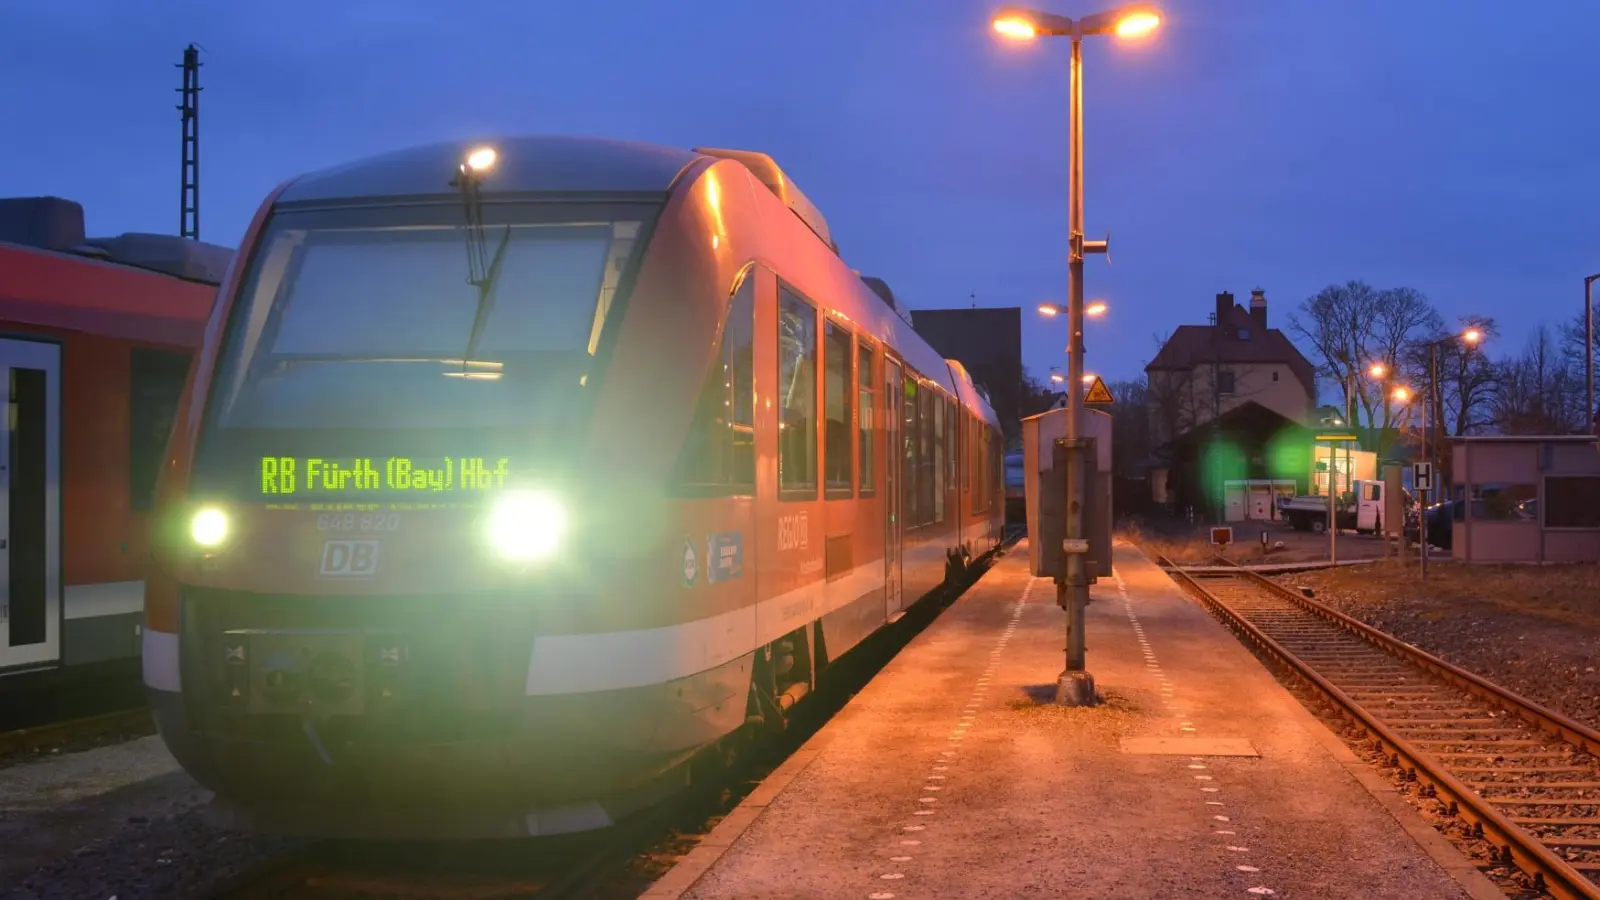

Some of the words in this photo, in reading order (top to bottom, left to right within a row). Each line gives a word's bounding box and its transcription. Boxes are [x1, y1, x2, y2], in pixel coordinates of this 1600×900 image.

[261, 457, 296, 494] RB
[307, 458, 380, 490] Fürth
[386, 456, 453, 492] (Bay)
[460, 457, 509, 491] Hbf
[1414, 463, 1430, 488] H
[321, 540, 378, 574] DB
